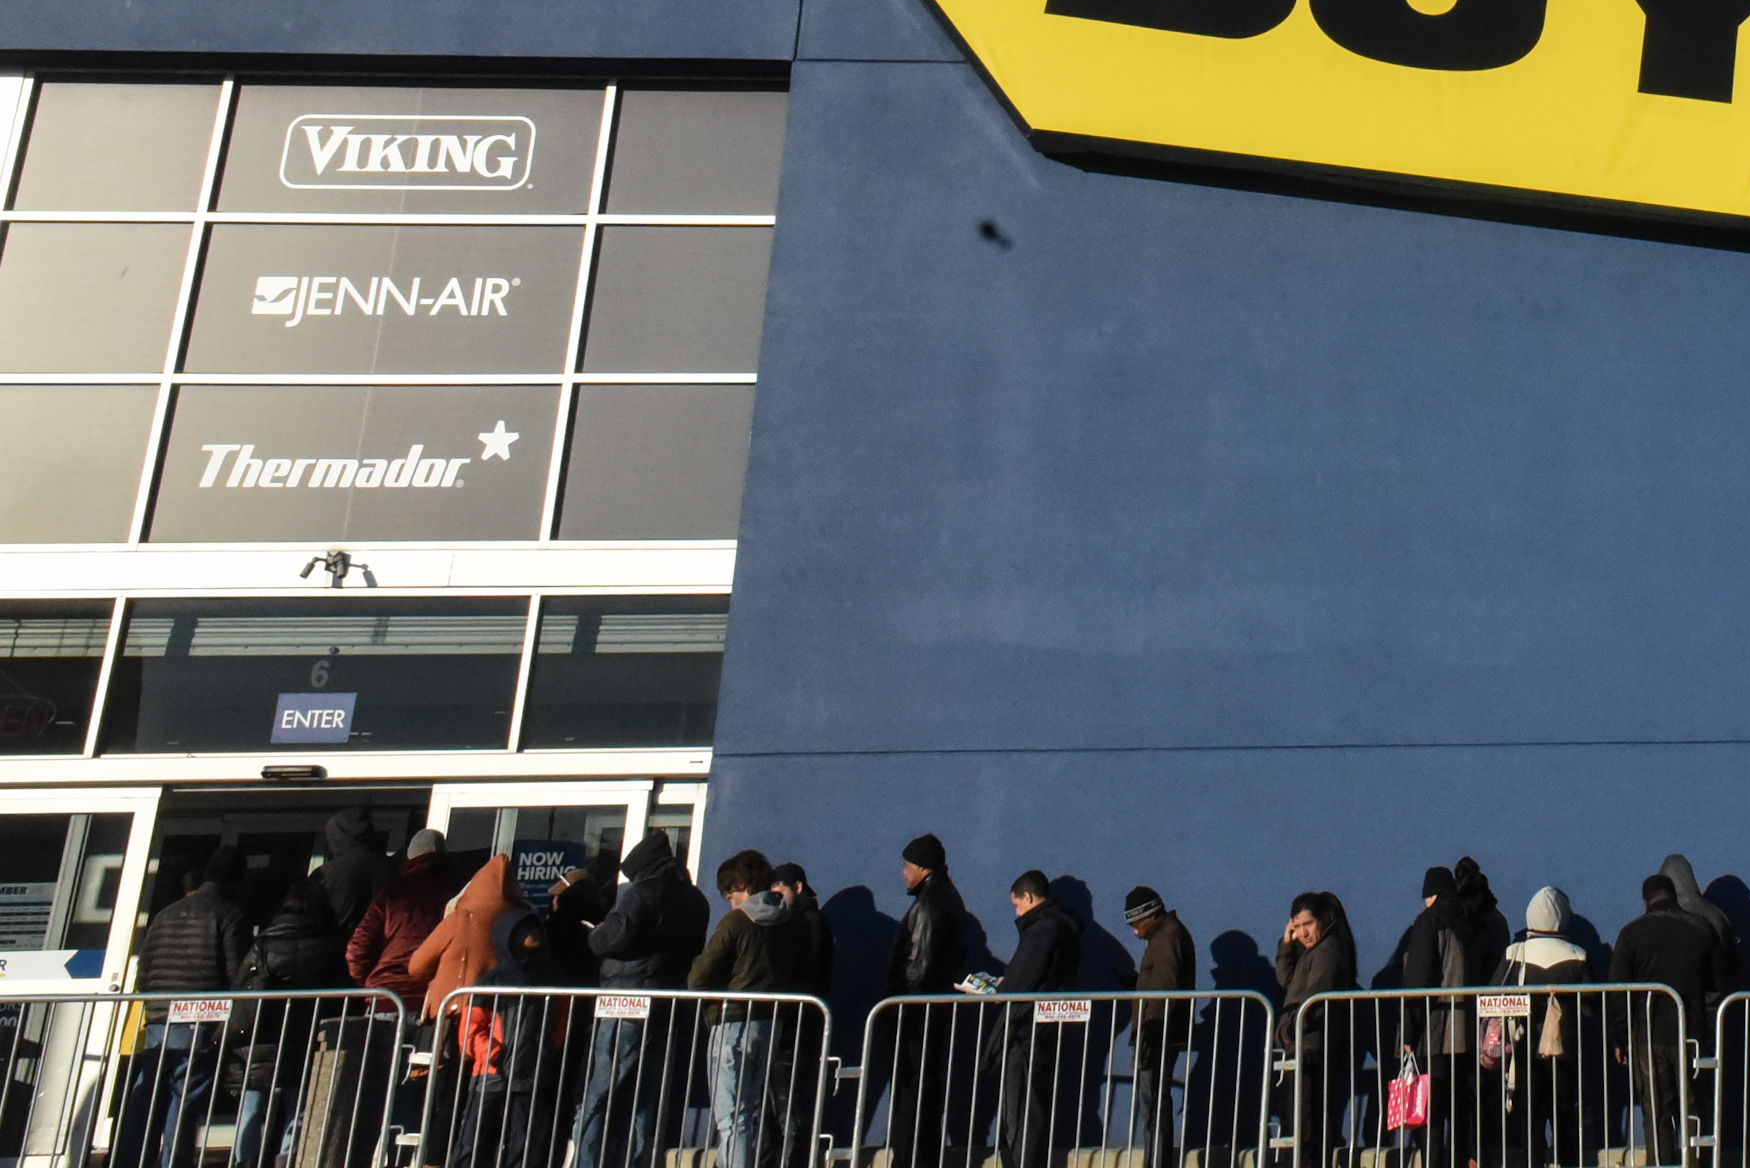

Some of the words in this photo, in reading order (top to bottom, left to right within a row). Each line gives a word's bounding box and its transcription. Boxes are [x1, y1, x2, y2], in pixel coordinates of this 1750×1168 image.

[301, 125, 519, 179] VIKING
[284, 276, 509, 328] JENN-AIR
[198, 443, 471, 488] Thermador
[310, 659, 331, 689] 6
[280, 709, 347, 729] ENTER
[518, 851, 565, 867] NOW
[173, 1001, 230, 1012] NATIONAL
[599, 997, 648, 1008] NATIONAL
[1037, 1002, 1089, 1012] NATIONAL
[1479, 997, 1528, 1007] NATIONAL
